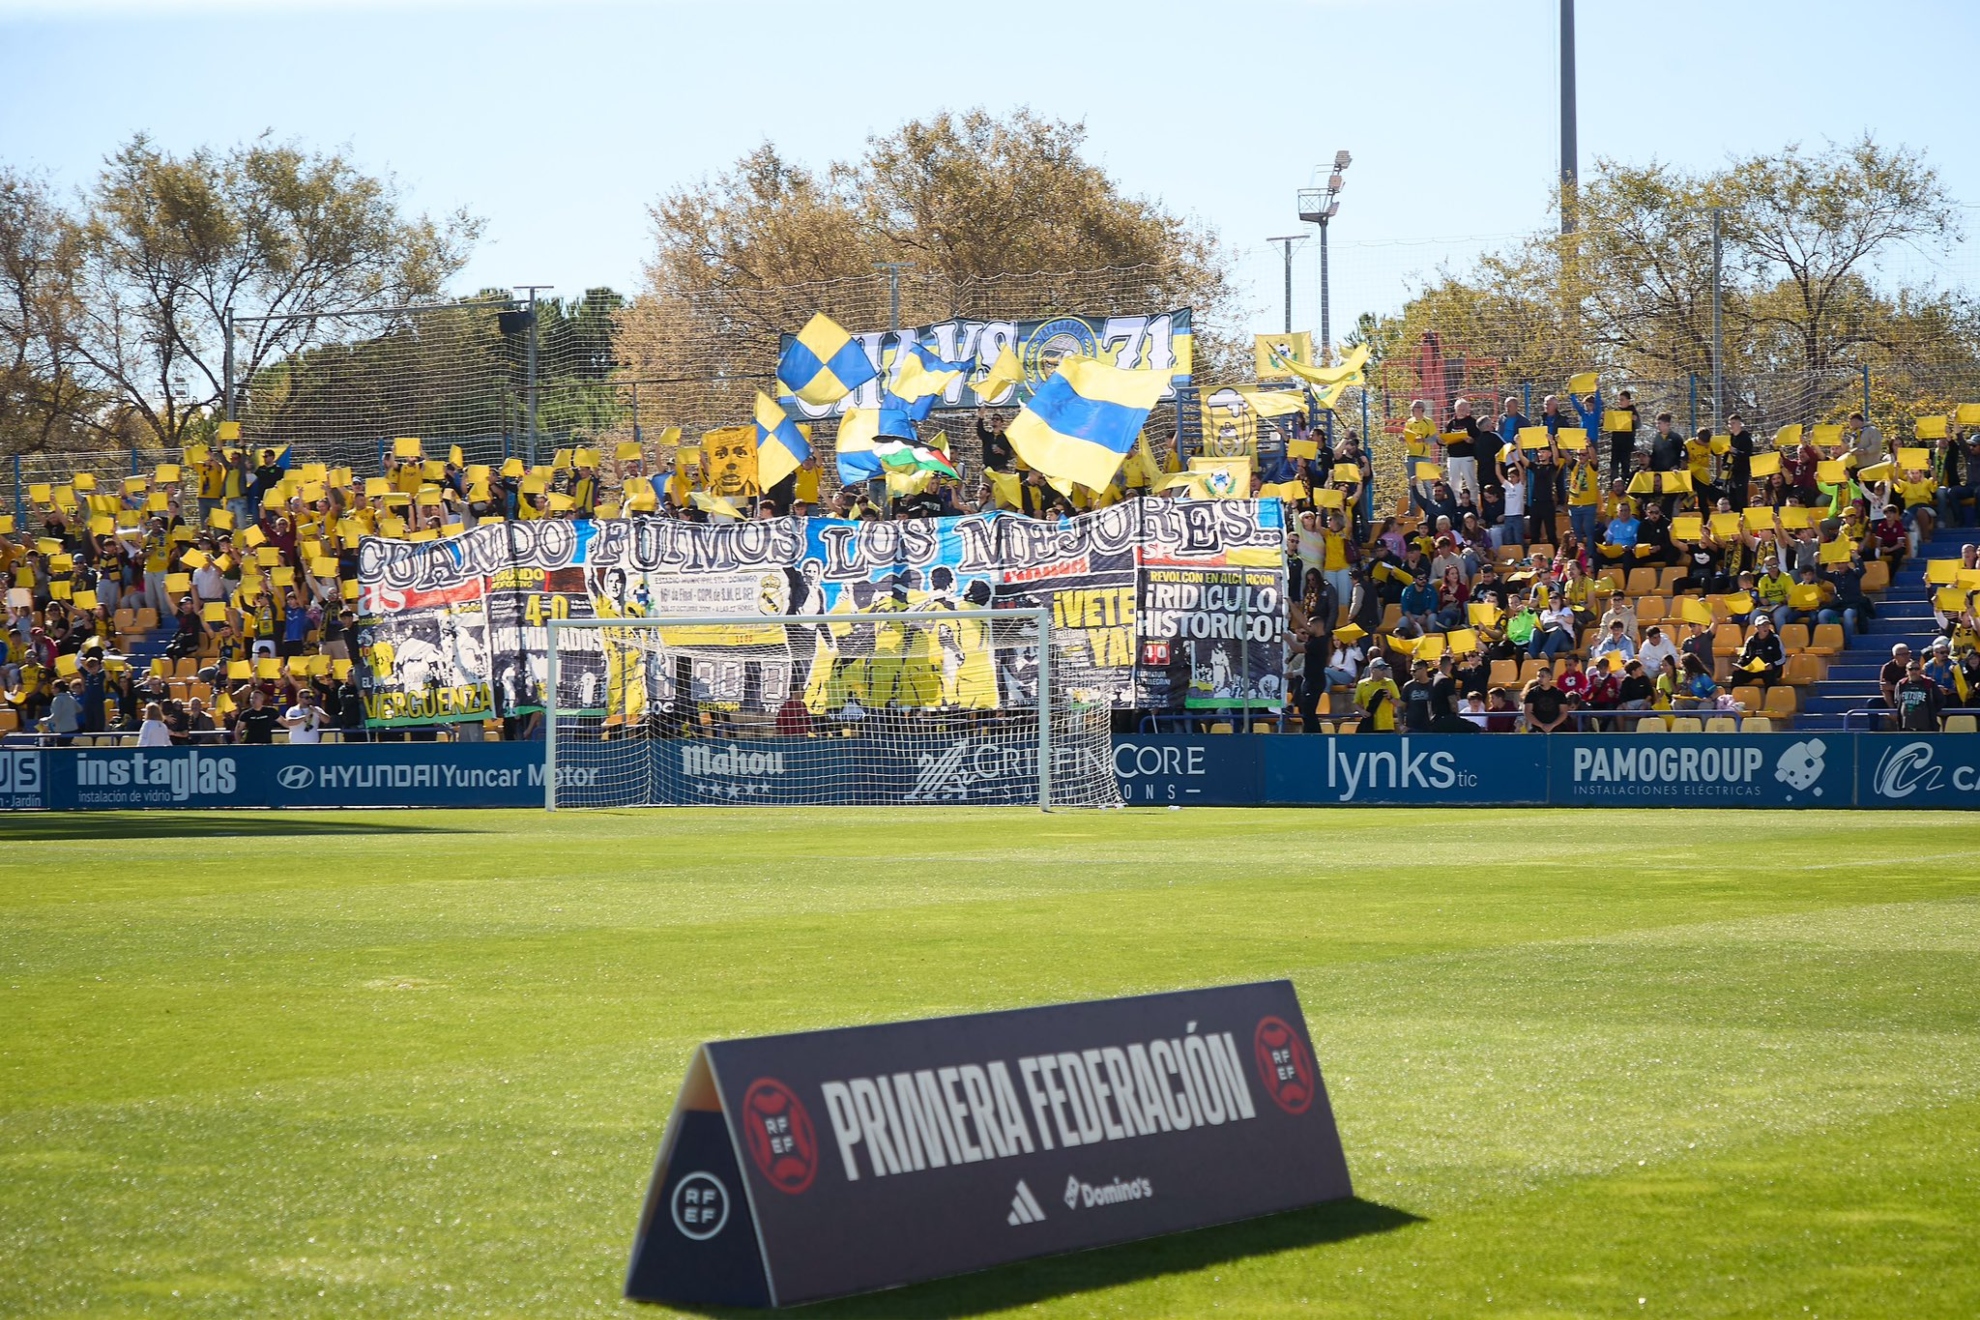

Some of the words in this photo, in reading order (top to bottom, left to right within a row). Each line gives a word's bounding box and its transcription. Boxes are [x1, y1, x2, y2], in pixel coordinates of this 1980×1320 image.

[1102, 313, 1177, 398] 71
[359, 518, 577, 590] CUANDO
[591, 515, 806, 573] FUIMOS
[820, 518, 937, 582] LOS
[1205, 573, 1220, 583] EN
[1221, 572, 1275, 585] ALCRCÓN
[524, 594, 568, 626] 4-0
[491, 626, 604, 655] ¡HUMILADOS
[1137, 609, 1283, 643] HISTORICO!
[764, 665, 783, 699] 0
[364, 682, 492, 719] VERGÜENZA
[680, 744, 786, 775] Mahou
[1327, 737, 1455, 802] lynks
[1457, 769, 1478, 788] tic
[1574, 747, 1763, 783] PAMOGROUP
[77, 750, 236, 801] instaglas
[320, 765, 438, 787] HYUNDAI
[440, 763, 520, 788] Yuncar
[1574, 785, 1678, 796] INSTALACIONES
[1684, 783, 1762, 797] ELÉCTRICAS
[11, 794, 42, 808] Jardín
[78, 789, 128, 803] instalación
[129, 790, 142, 802] de
[143, 789, 172, 802] vidrio
[1002, 784, 1177, 800] SOUTIONS
[1271, 1048, 1290, 1065] RF
[1276, 1065, 1295, 1081] EF
[821, 1060, 1034, 1182] PRIMERA
[1018, 1020, 1256, 1151] FEDERACIÓN
[764, 1116, 788, 1135] RF
[770, 1136, 793, 1154] EF
[685, 1188, 716, 1205] RF
[1081, 1176, 1153, 1208] Domino's
[683, 1207, 715, 1224] EF
